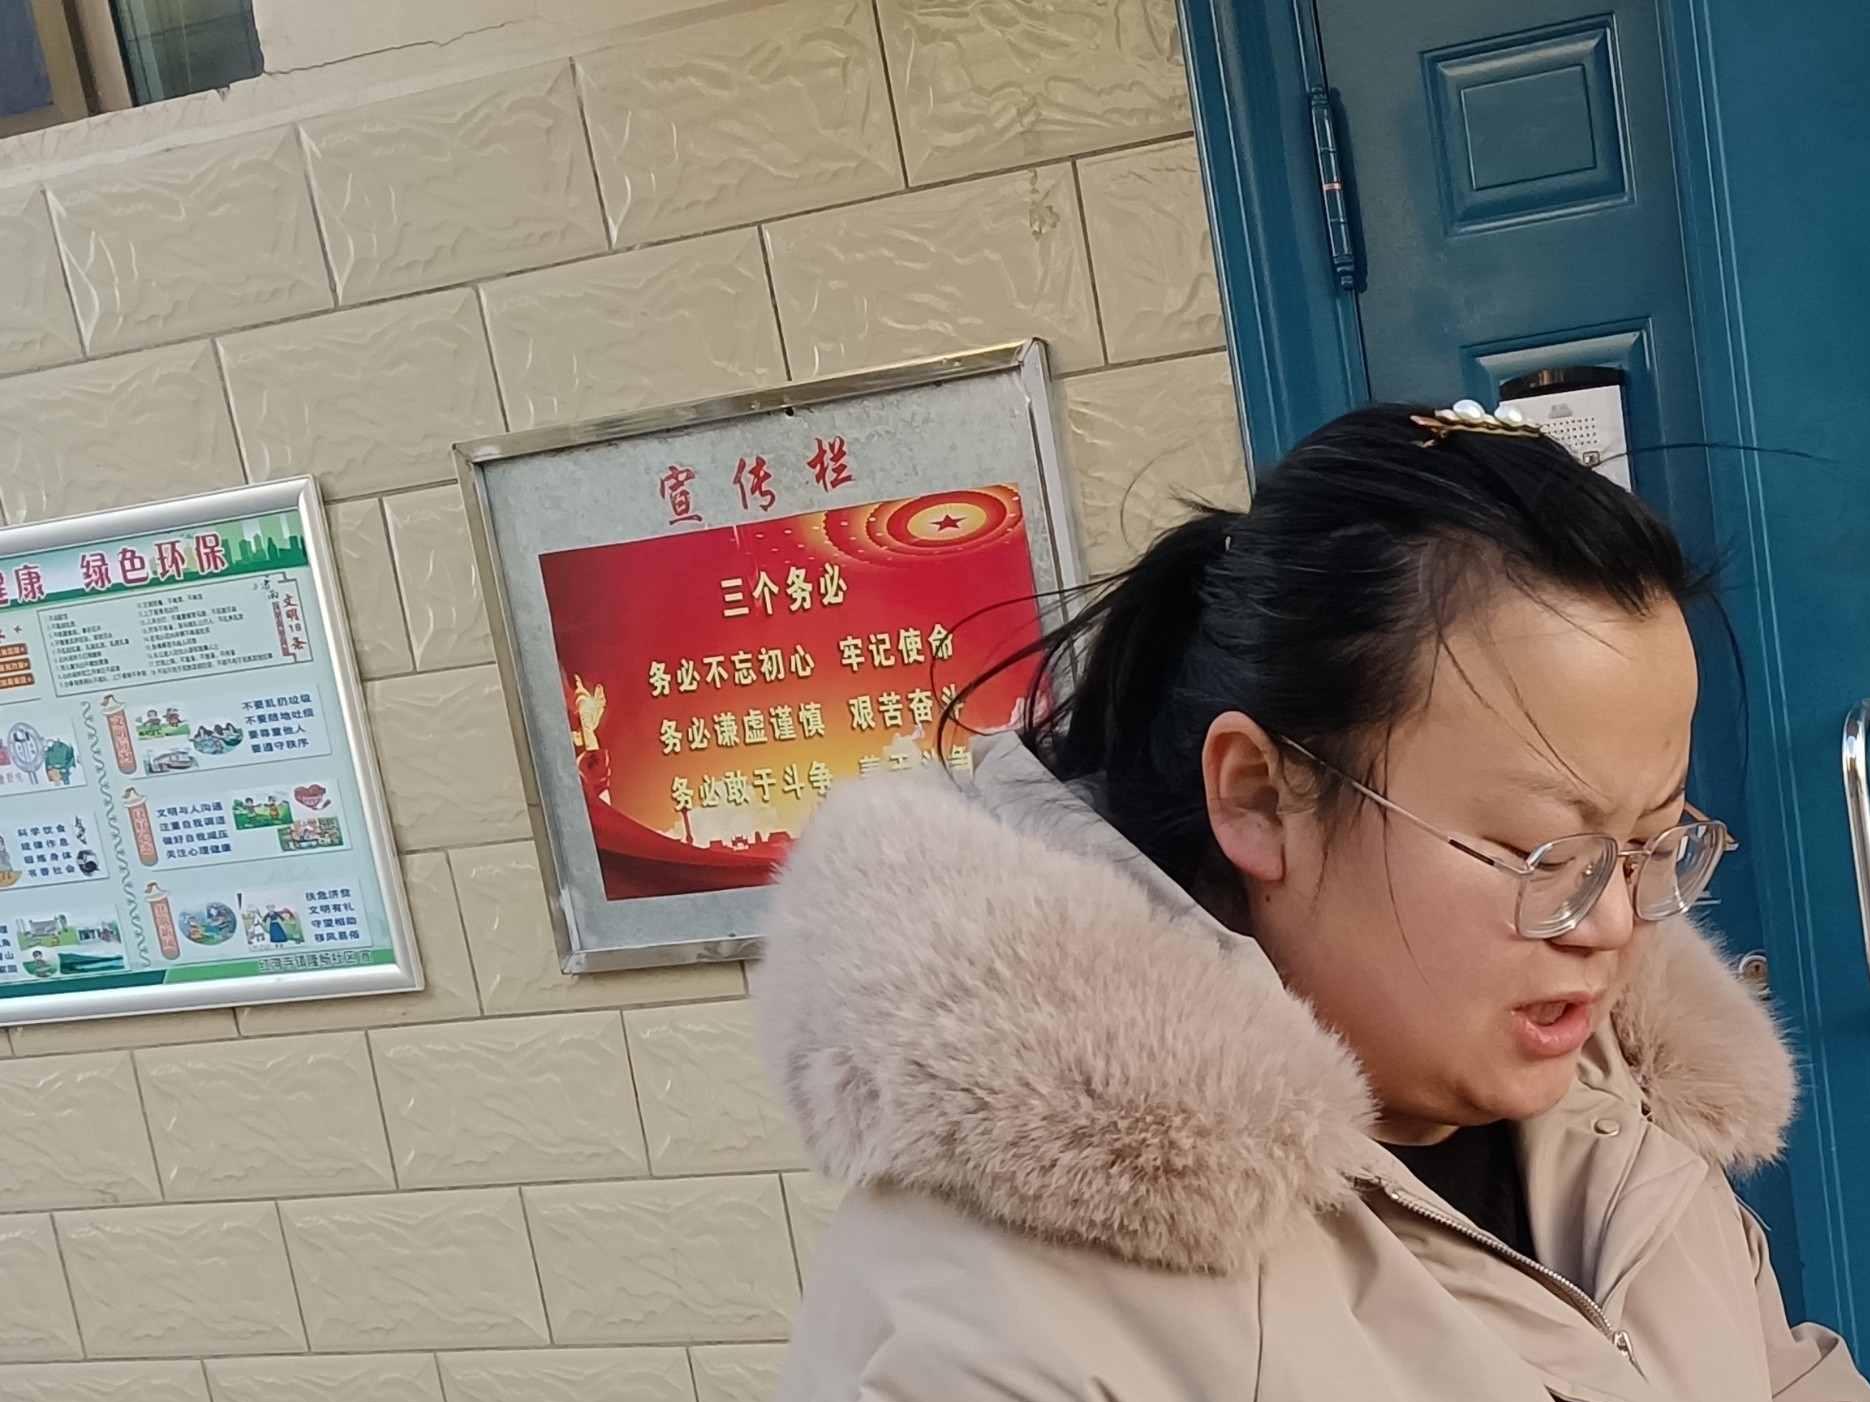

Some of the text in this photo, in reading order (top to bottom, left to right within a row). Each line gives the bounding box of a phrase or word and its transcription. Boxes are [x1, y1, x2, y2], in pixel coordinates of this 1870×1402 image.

[658, 436, 855, 526] 宣传栏
[80, 533, 227, 589] 绿色环保
[720, 563, 849, 618] 三个务必
[648, 623, 955, 697] 务必不忘初心 牢记使命
[660, 684, 964, 755] 务必谦虚谨慎 艰苦奋斗
[671, 759, 834, 811] 务必敢于斗争
